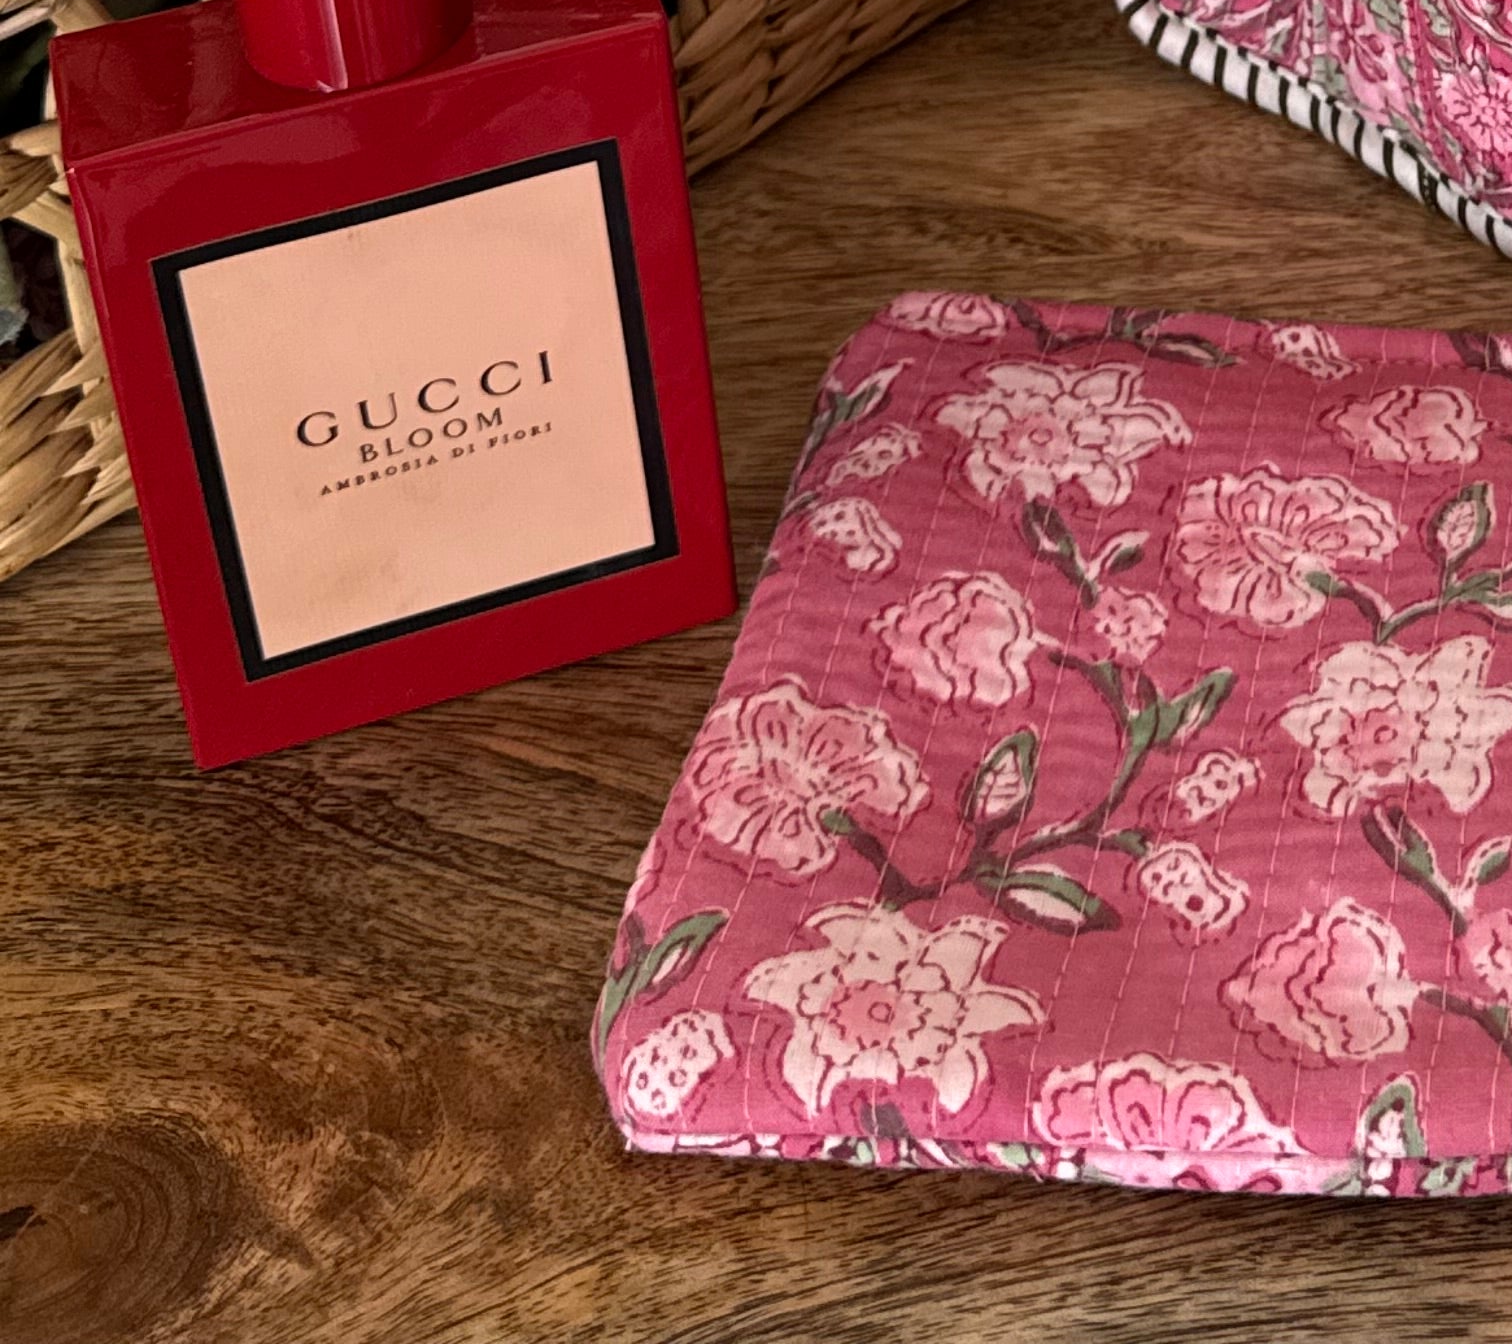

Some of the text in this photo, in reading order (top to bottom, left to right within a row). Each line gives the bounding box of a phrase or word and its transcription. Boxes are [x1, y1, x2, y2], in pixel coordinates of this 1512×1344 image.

[296, 350, 553, 447] GUCCI
[359, 407, 503, 464] BLOOM
[319, 421, 553, 496] AMBROSIA DI FIORI
